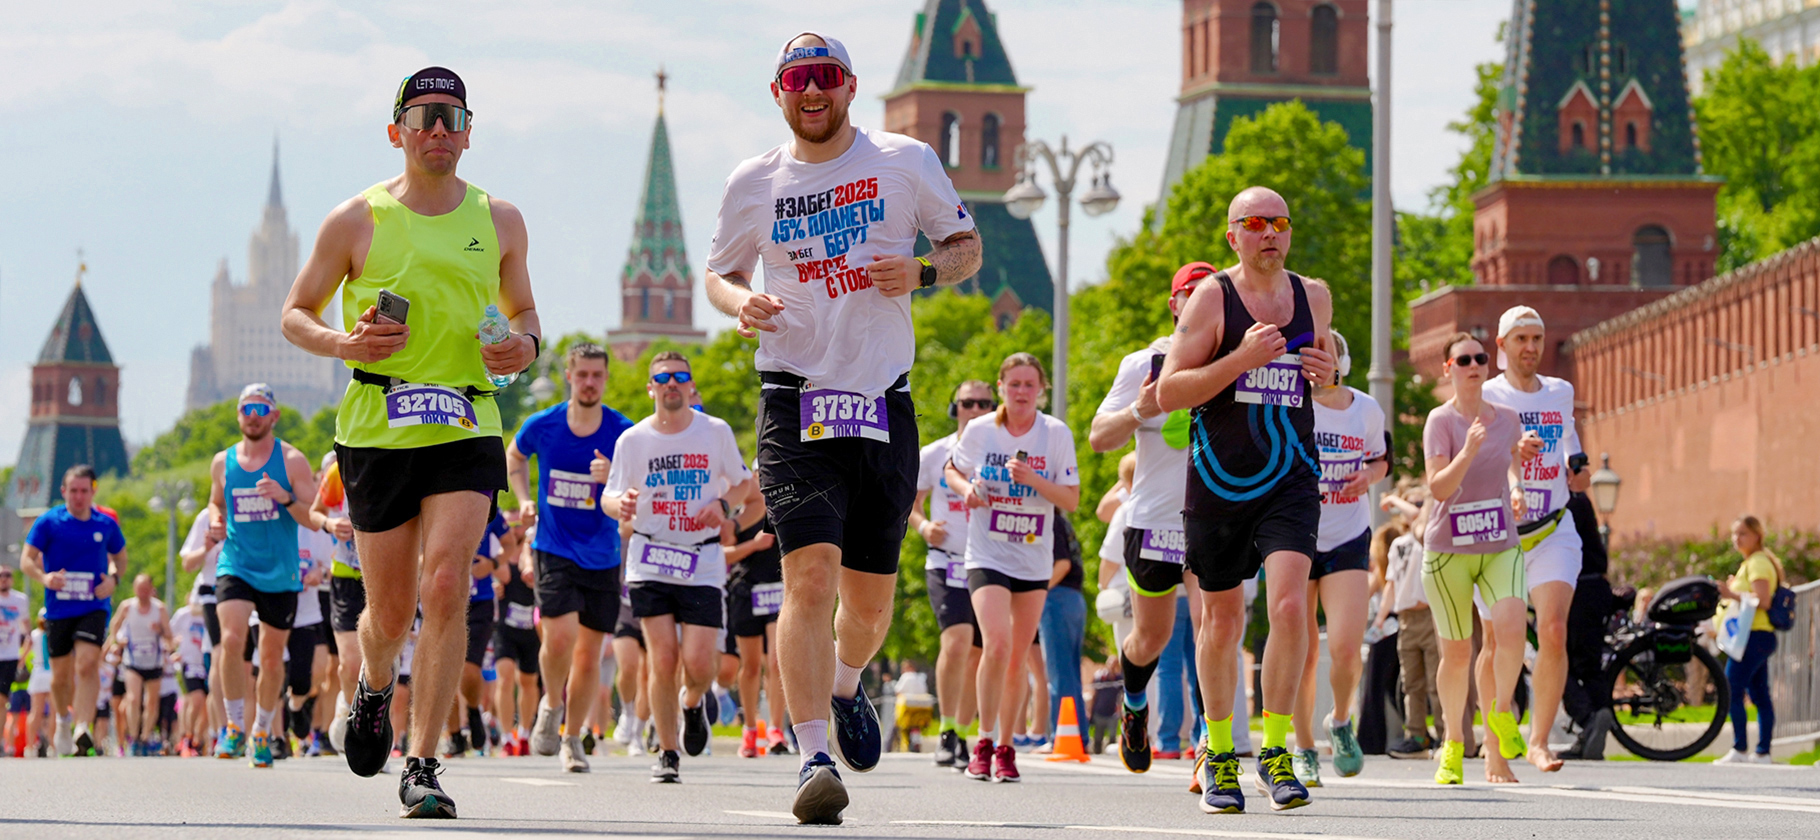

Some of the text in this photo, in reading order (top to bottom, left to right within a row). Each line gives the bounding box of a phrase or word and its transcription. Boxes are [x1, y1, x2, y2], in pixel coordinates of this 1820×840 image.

[435, 78, 455, 90] MOVE
[775, 177, 879, 220] #ЗАБЕГ2025
[771, 199, 886, 245] 45% ПЛАНЕТЫ
[823, 224, 869, 258] БЕГУТ
[795, 254, 849, 283] ВМЕСТЕ
[1245, 366, 1298, 392] 30037
[396, 392, 467, 417] 32705
[812, 394, 879, 424] 37372
[1261, 392, 1283, 406] 10KM
[420, 413, 449, 425] 10KM
[811, 424, 861, 438] B 10KM
[648, 454, 709, 473] #ЗАБЕГ2025
[645, 470, 711, 488] 45% ПЛАНЕТЫ
[675, 485, 702, 501] БЕГУТ
[652, 501, 687, 517] ВМЕСТЕ
[996, 513, 1038, 534] 60194
[1456, 510, 1499, 535] 60547
[1149, 529, 1185, 552] 3395
[646, 547, 692, 571] 35306
